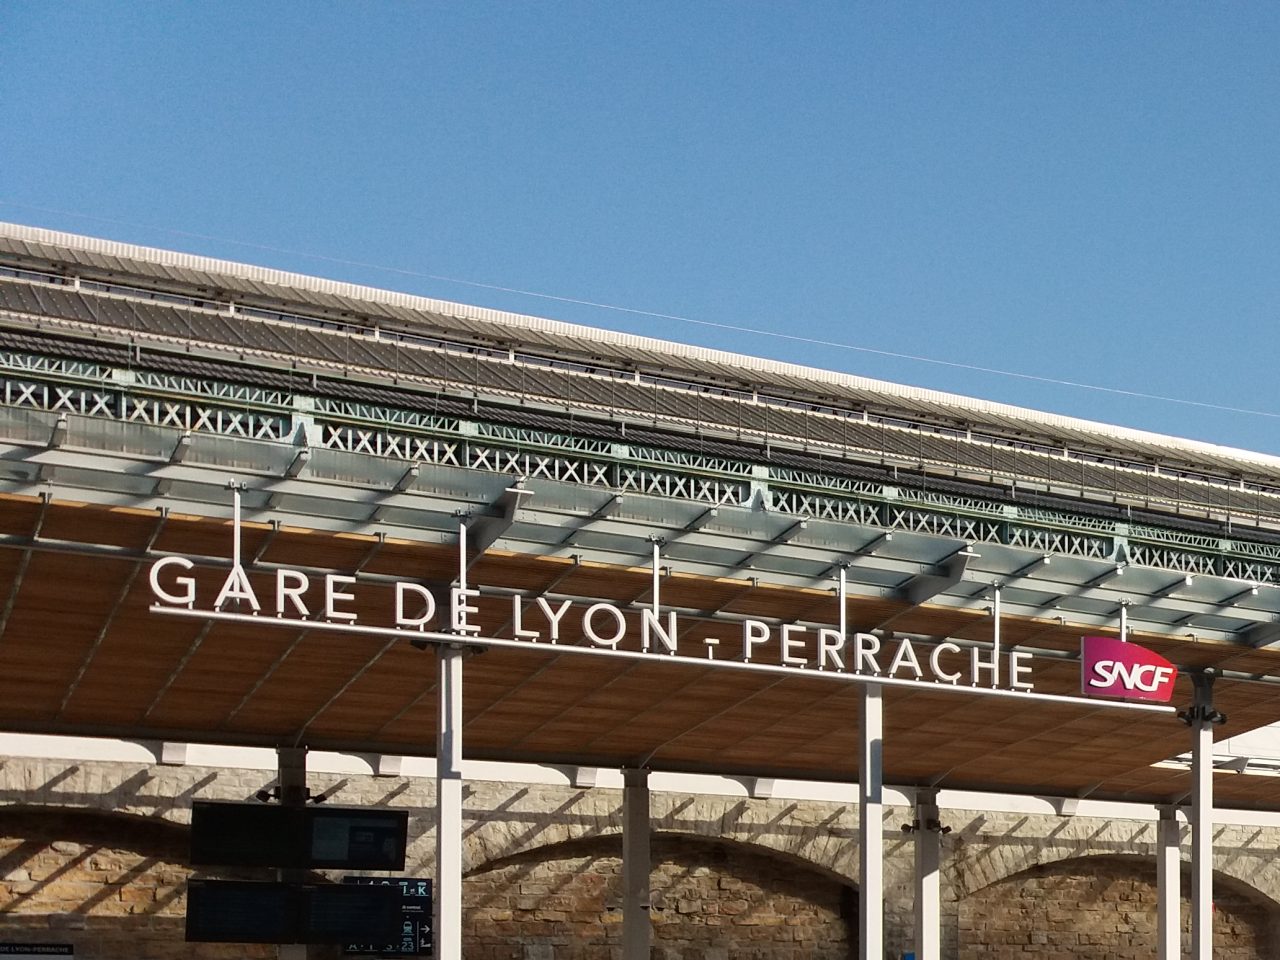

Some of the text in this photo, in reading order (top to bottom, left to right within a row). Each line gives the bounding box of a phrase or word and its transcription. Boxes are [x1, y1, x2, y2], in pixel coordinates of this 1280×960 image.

[149, 556, 357, 621] GARE
[395, 581, 482, 632] DE
[512, 594, 678, 651] LYON
[742, 619, 1034, 689] PERRACHE
[1089, 660, 1174, 692] SNCF
[418, 886, 426, 895] K
